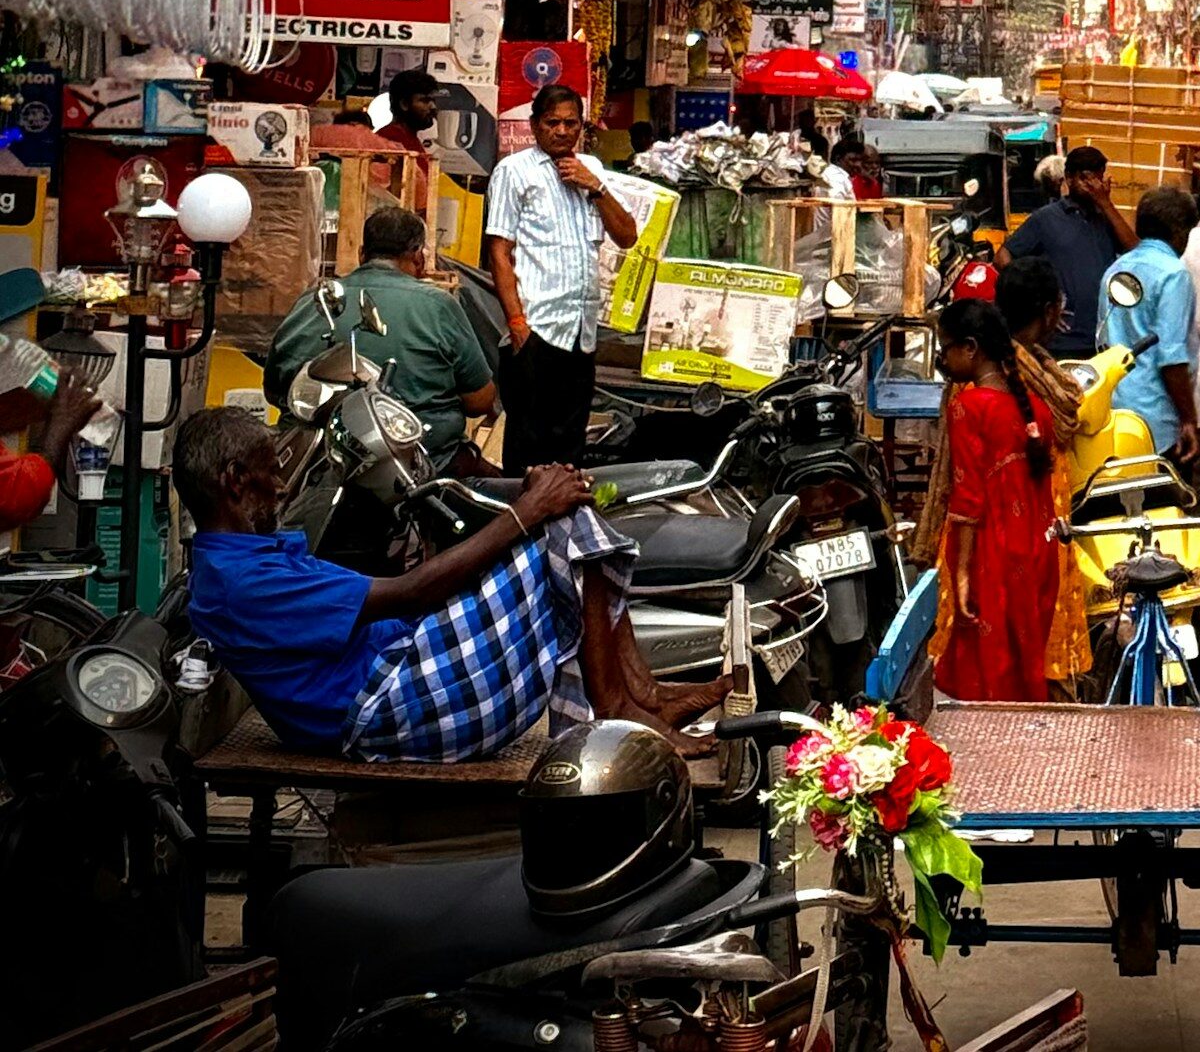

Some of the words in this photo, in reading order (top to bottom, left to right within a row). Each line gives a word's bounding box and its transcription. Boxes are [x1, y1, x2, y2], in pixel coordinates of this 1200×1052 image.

[9, 72, 55, 86] pton
[690, 269, 786, 292] ALMONARD
[816, 549, 863, 572] 07078
